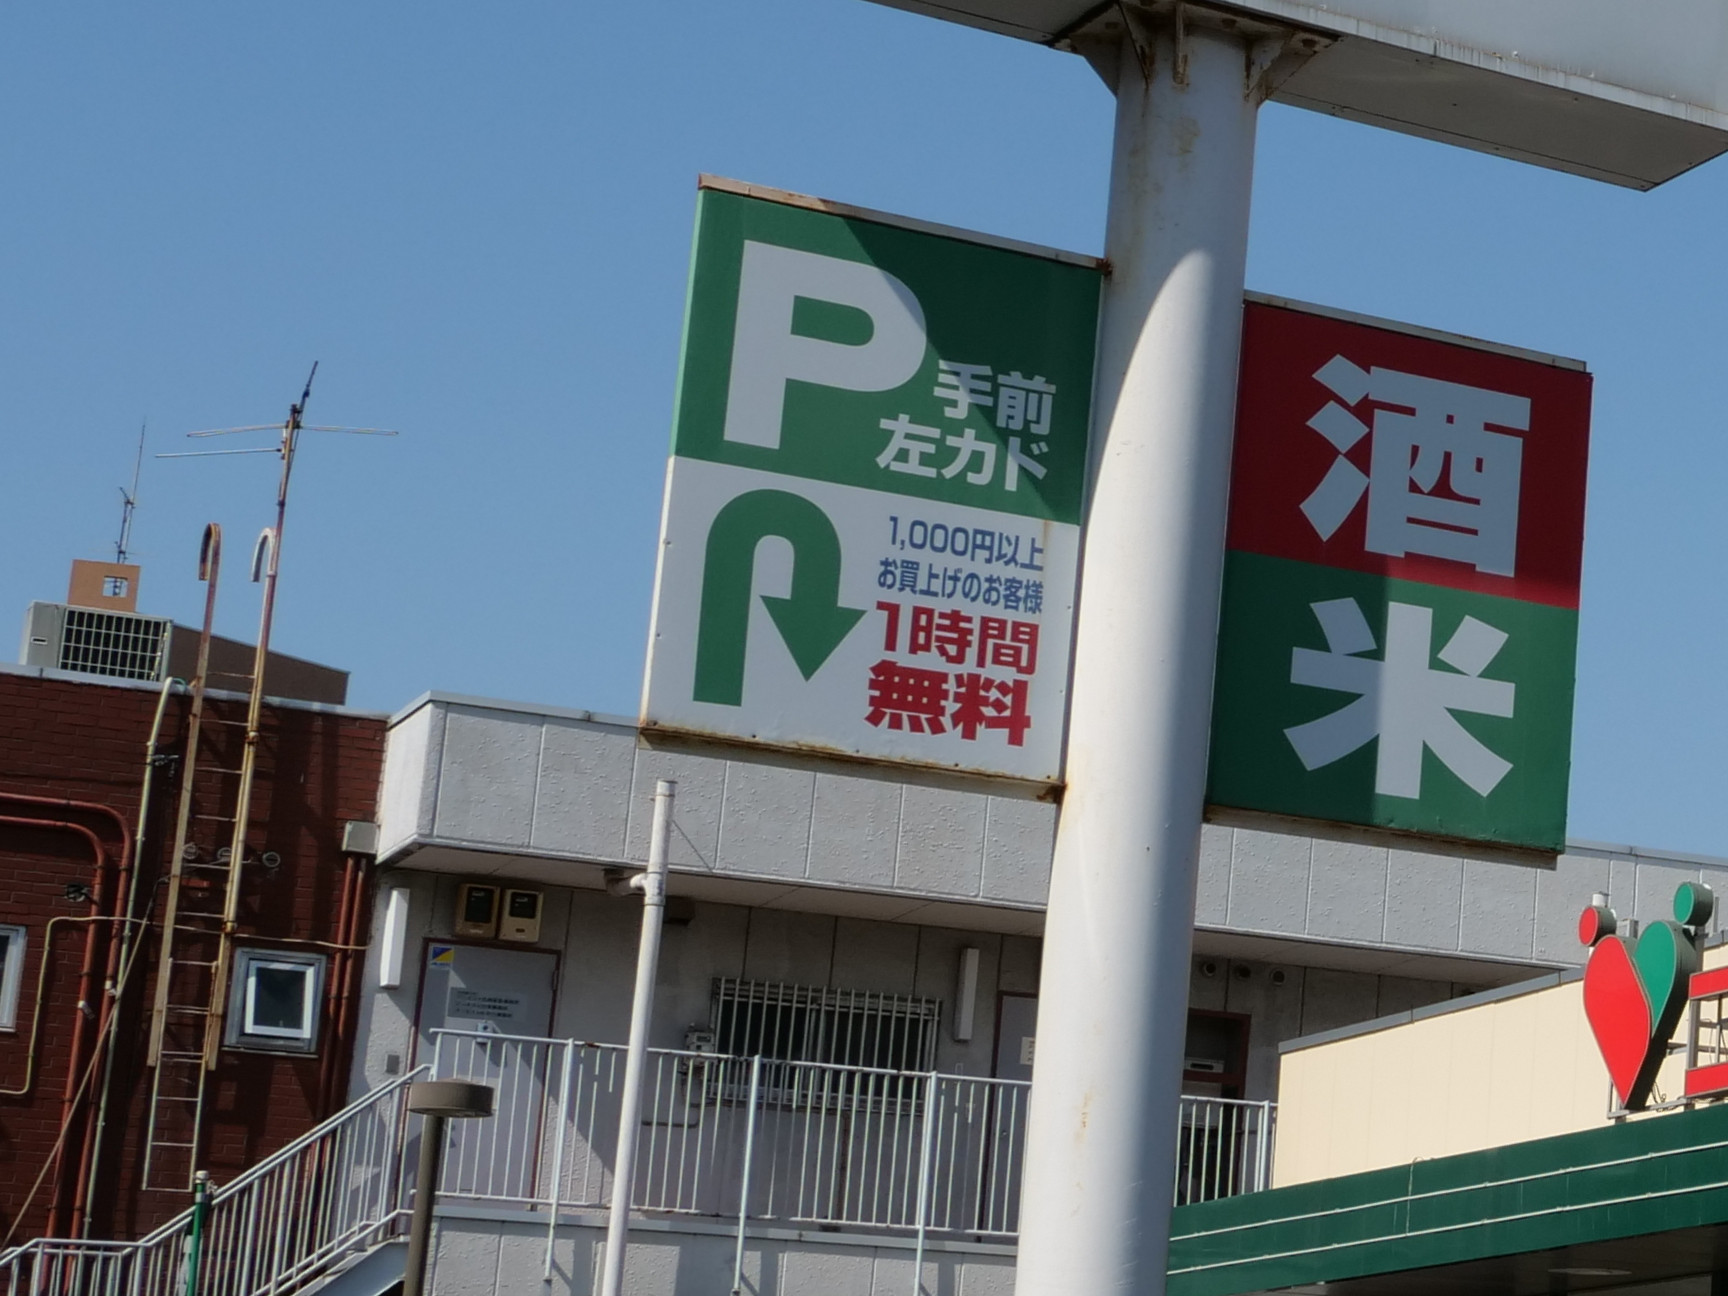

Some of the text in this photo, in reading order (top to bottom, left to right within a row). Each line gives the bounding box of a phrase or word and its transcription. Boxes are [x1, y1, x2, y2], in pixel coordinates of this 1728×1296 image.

[724, 240, 927, 449] P
[933, 359, 1057, 435] 手前
[875, 413, 1049, 491] 左カド
[1298, 353, 1532, 578] 酒
[889, 516, 1044, 571] 1,000円以上
[877, 557, 1044, 614] お買上げのお客様
[876, 600, 1039, 675] 1時間
[864, 659, 1031, 747] 無料
[1283, 596, 1515, 799] 米
